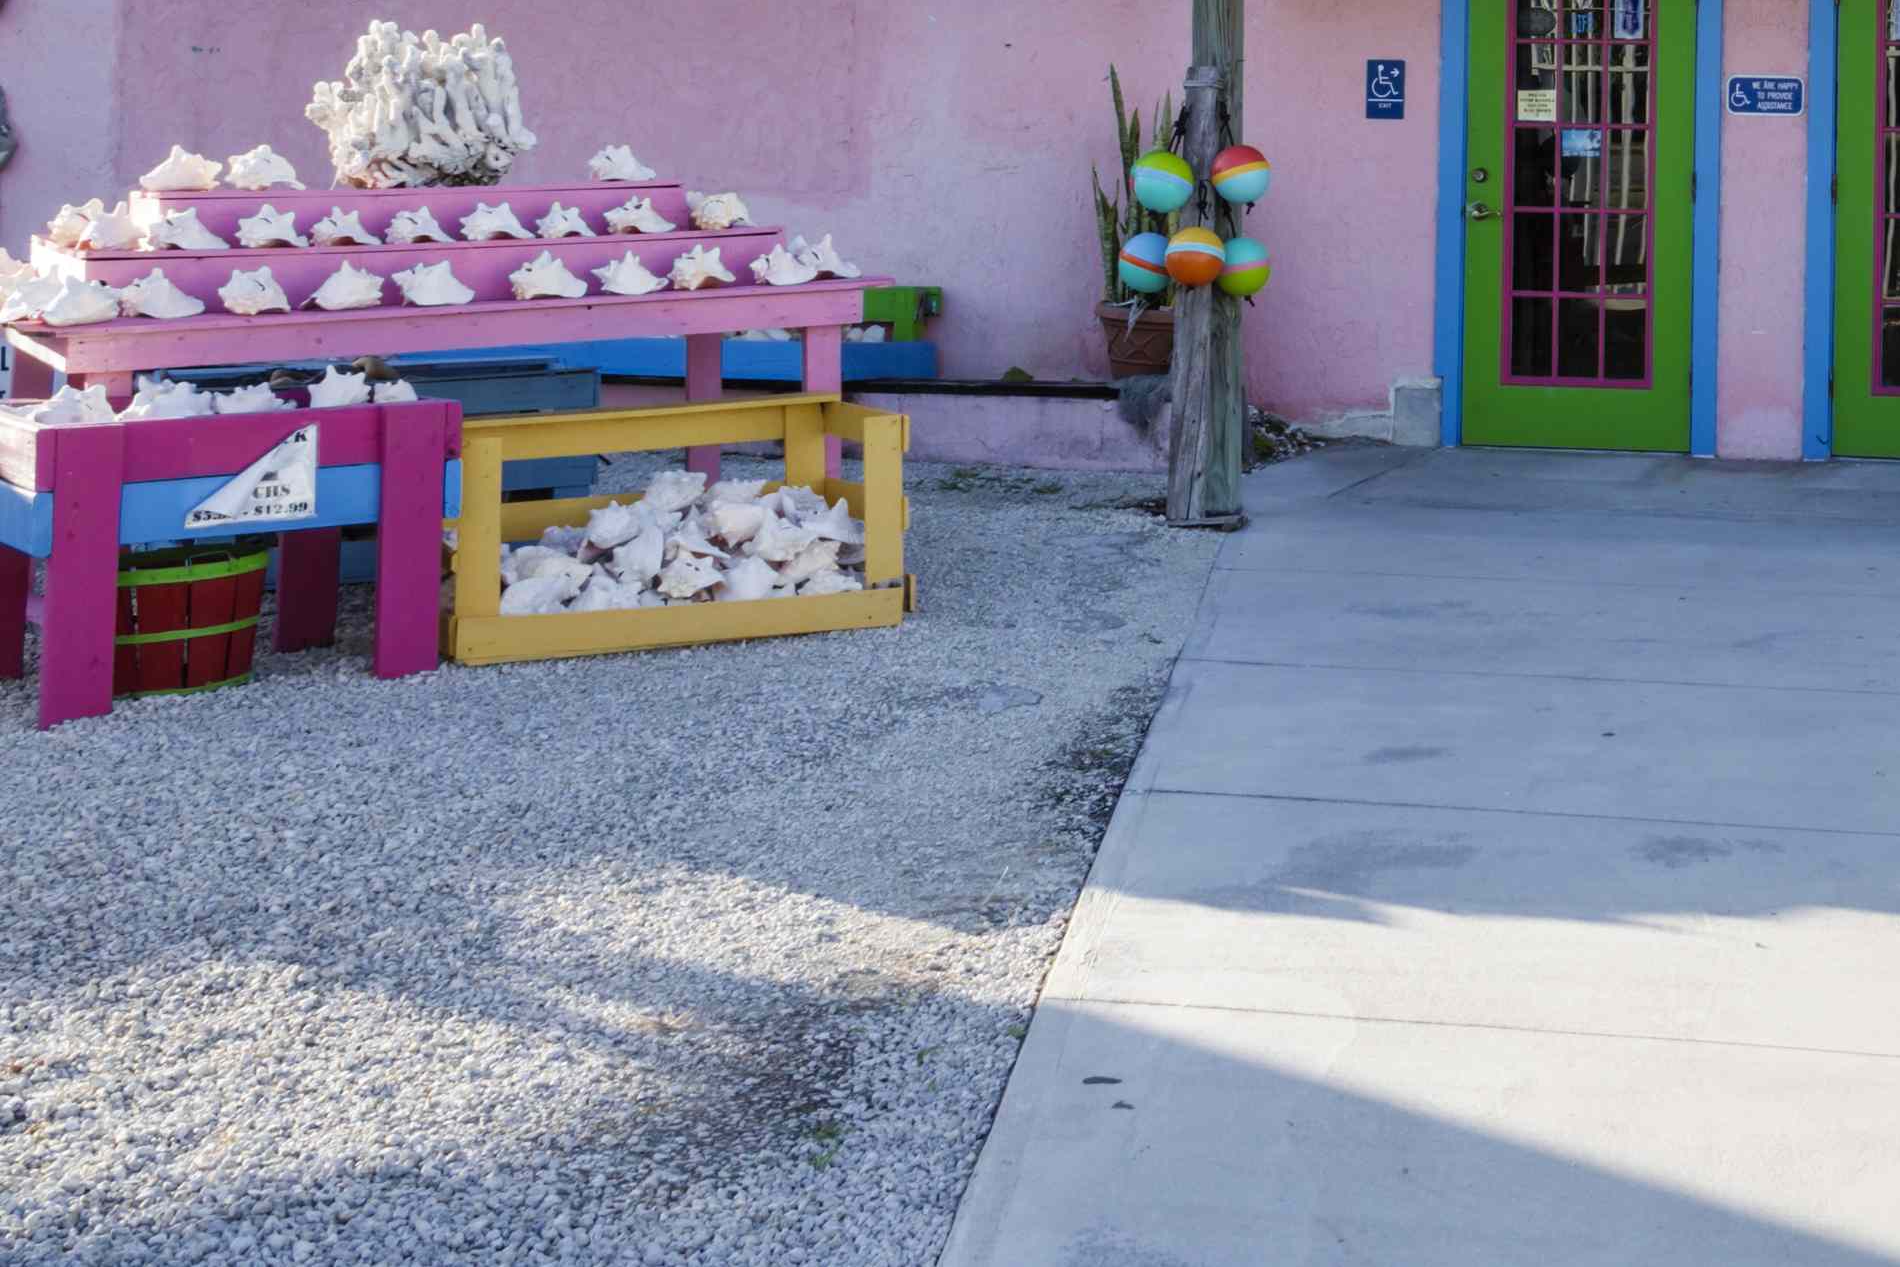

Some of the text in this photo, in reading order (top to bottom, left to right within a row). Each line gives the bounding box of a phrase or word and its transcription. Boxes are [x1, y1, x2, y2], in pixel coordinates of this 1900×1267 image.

[1751, 80, 1799, 91] WE ARE HAPPY
[1757, 91, 1793, 101] TO PROVIDE
[1757, 101, 1793, 111] ASSISTANCE
[253, 501, 308, 515] $12.99
